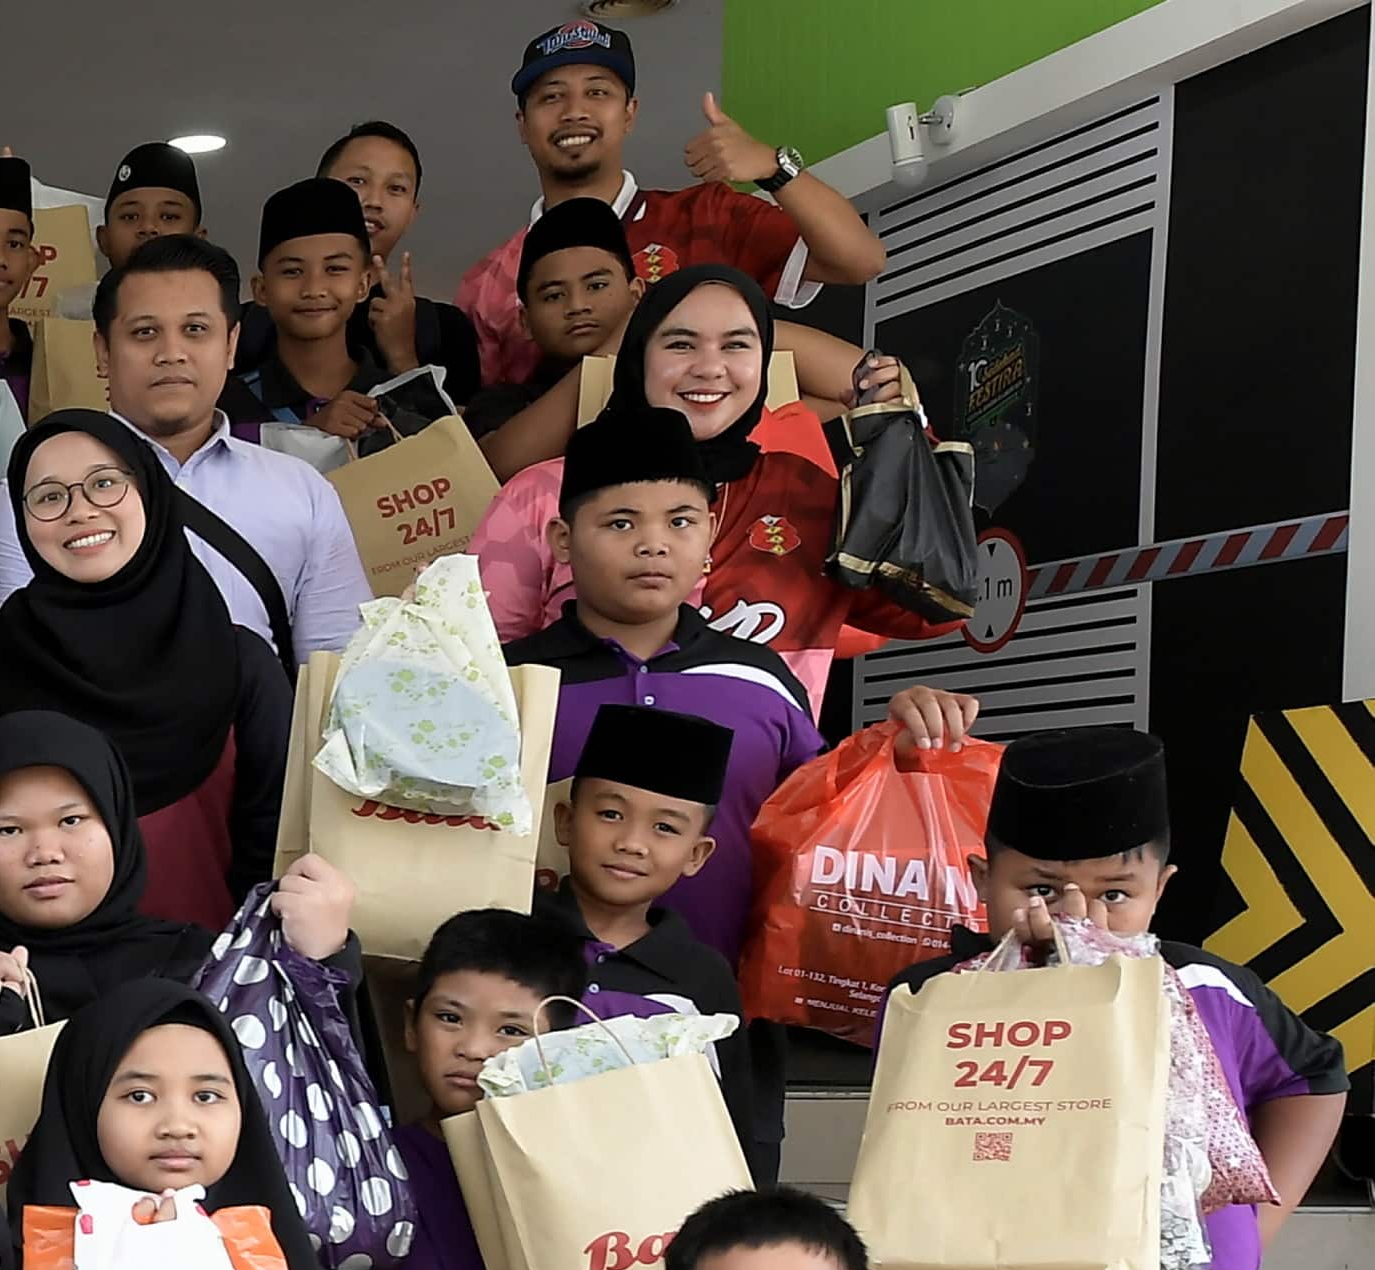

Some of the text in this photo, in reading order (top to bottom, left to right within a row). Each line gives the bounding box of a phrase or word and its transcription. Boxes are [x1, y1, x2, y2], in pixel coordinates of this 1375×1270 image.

[376, 477, 451, 518] SHOP
[396, 507, 455, 545] 24/7
[809, 845, 930, 901] DINA
[816, 894, 977, 930] COLLECT
[945, 1020, 1072, 1049] SHOP
[953, 1055, 1055, 1090] 24/7
[887, 1098, 1113, 1114] FROM OUR LARGEST STORE
[944, 1116, 1046, 1127] BATA.COM.MY
